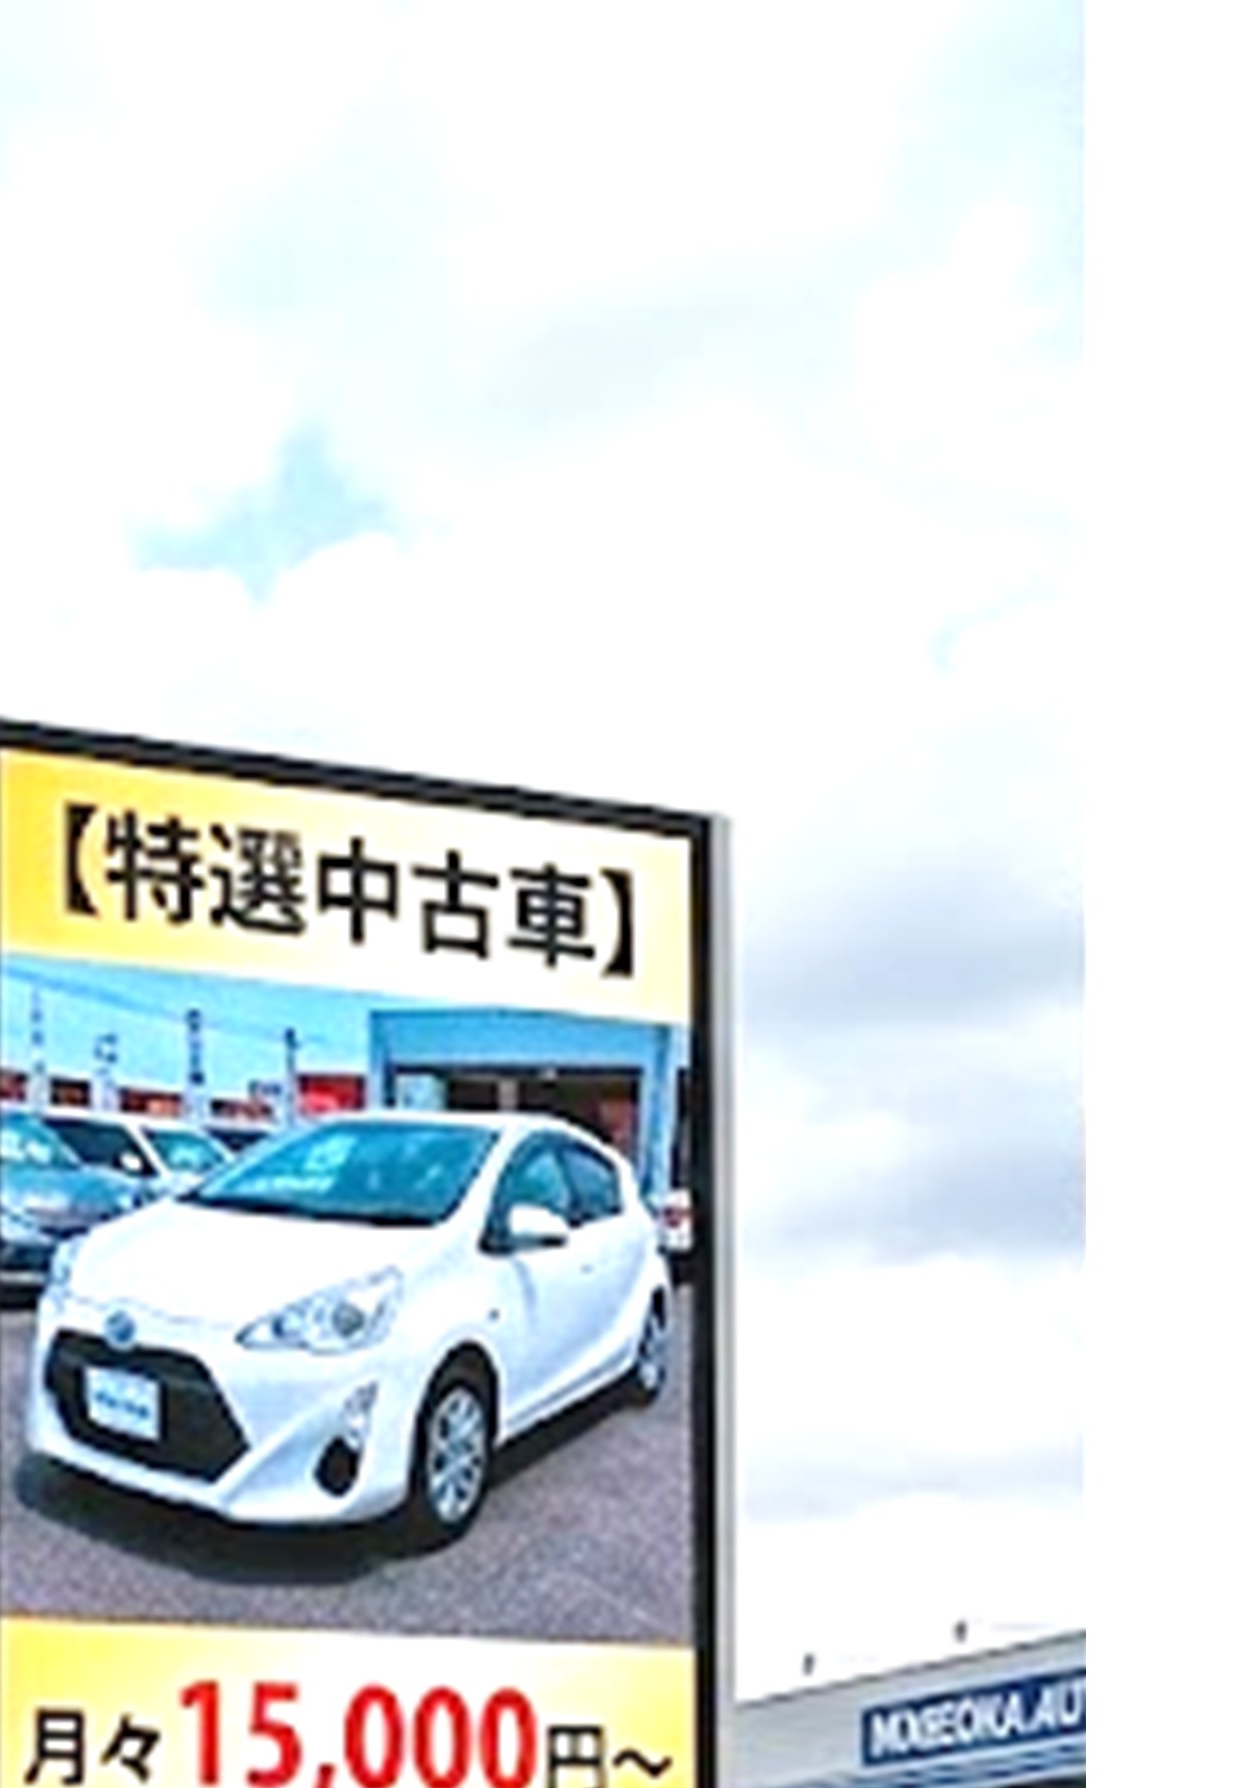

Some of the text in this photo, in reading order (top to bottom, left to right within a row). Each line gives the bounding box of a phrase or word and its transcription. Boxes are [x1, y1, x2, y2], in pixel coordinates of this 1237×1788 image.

[64, 801, 634, 978] 【特選中古車】
